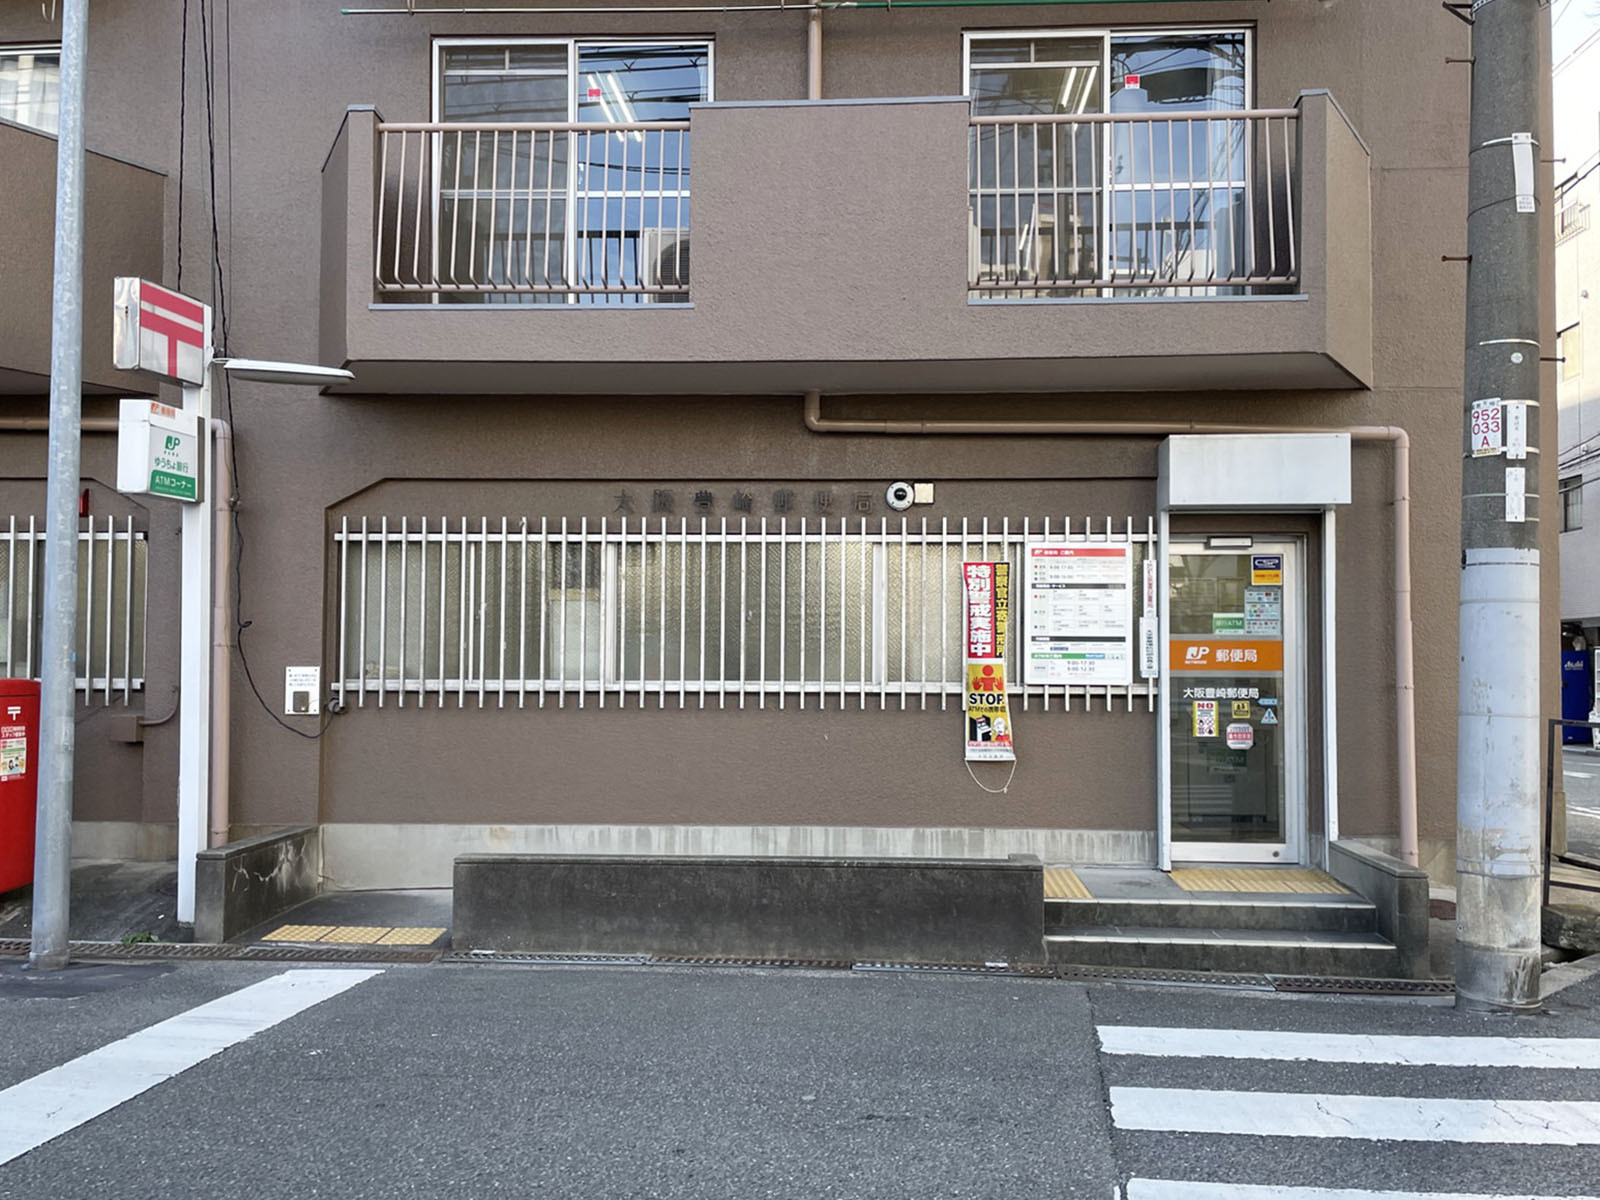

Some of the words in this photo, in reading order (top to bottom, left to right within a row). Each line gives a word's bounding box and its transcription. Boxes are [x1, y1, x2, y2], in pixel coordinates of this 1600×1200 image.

[1472, 408, 1500, 422] 952
[1472, 421, 1500, 436] 033
[165, 435, 181, 451] JP
[1481, 435, 1490, 447] A
[154, 457, 189, 473] ゆうちょ銀行
[155, 476, 192, 489] ATMコーナー
[1216, 649, 1257, 663] 郵便局
[969, 693, 1004, 705] STOP
[1183, 687, 1259, 699] 大阪豊崎郵便局
